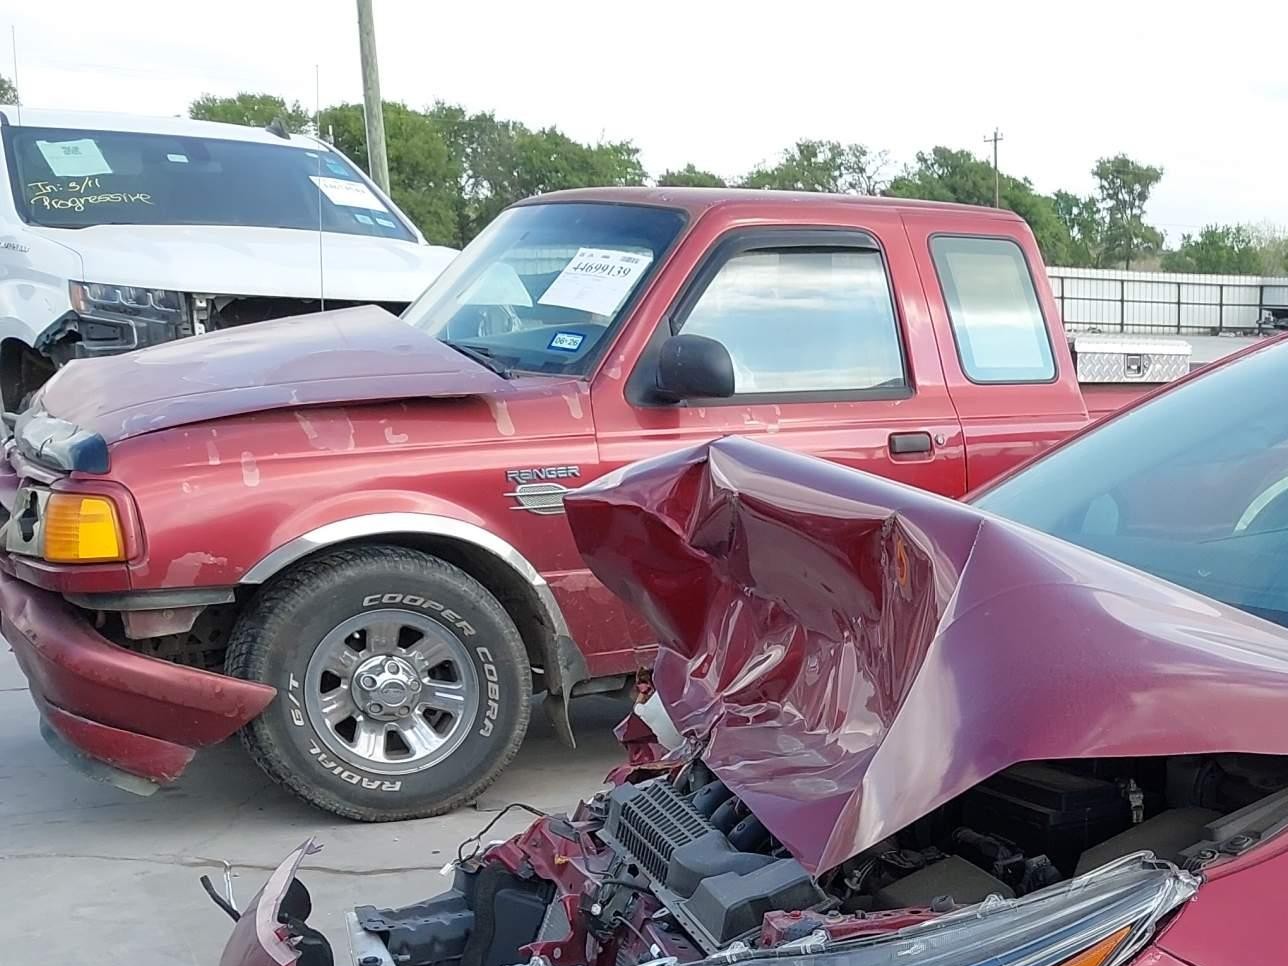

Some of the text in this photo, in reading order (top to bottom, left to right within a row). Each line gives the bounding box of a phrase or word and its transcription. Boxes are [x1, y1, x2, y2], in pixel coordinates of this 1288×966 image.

[572, 261, 632, 278] 44699139
[363, 593, 500, 737] COOPER COBRA
[308, 739, 402, 792] RADIAL
